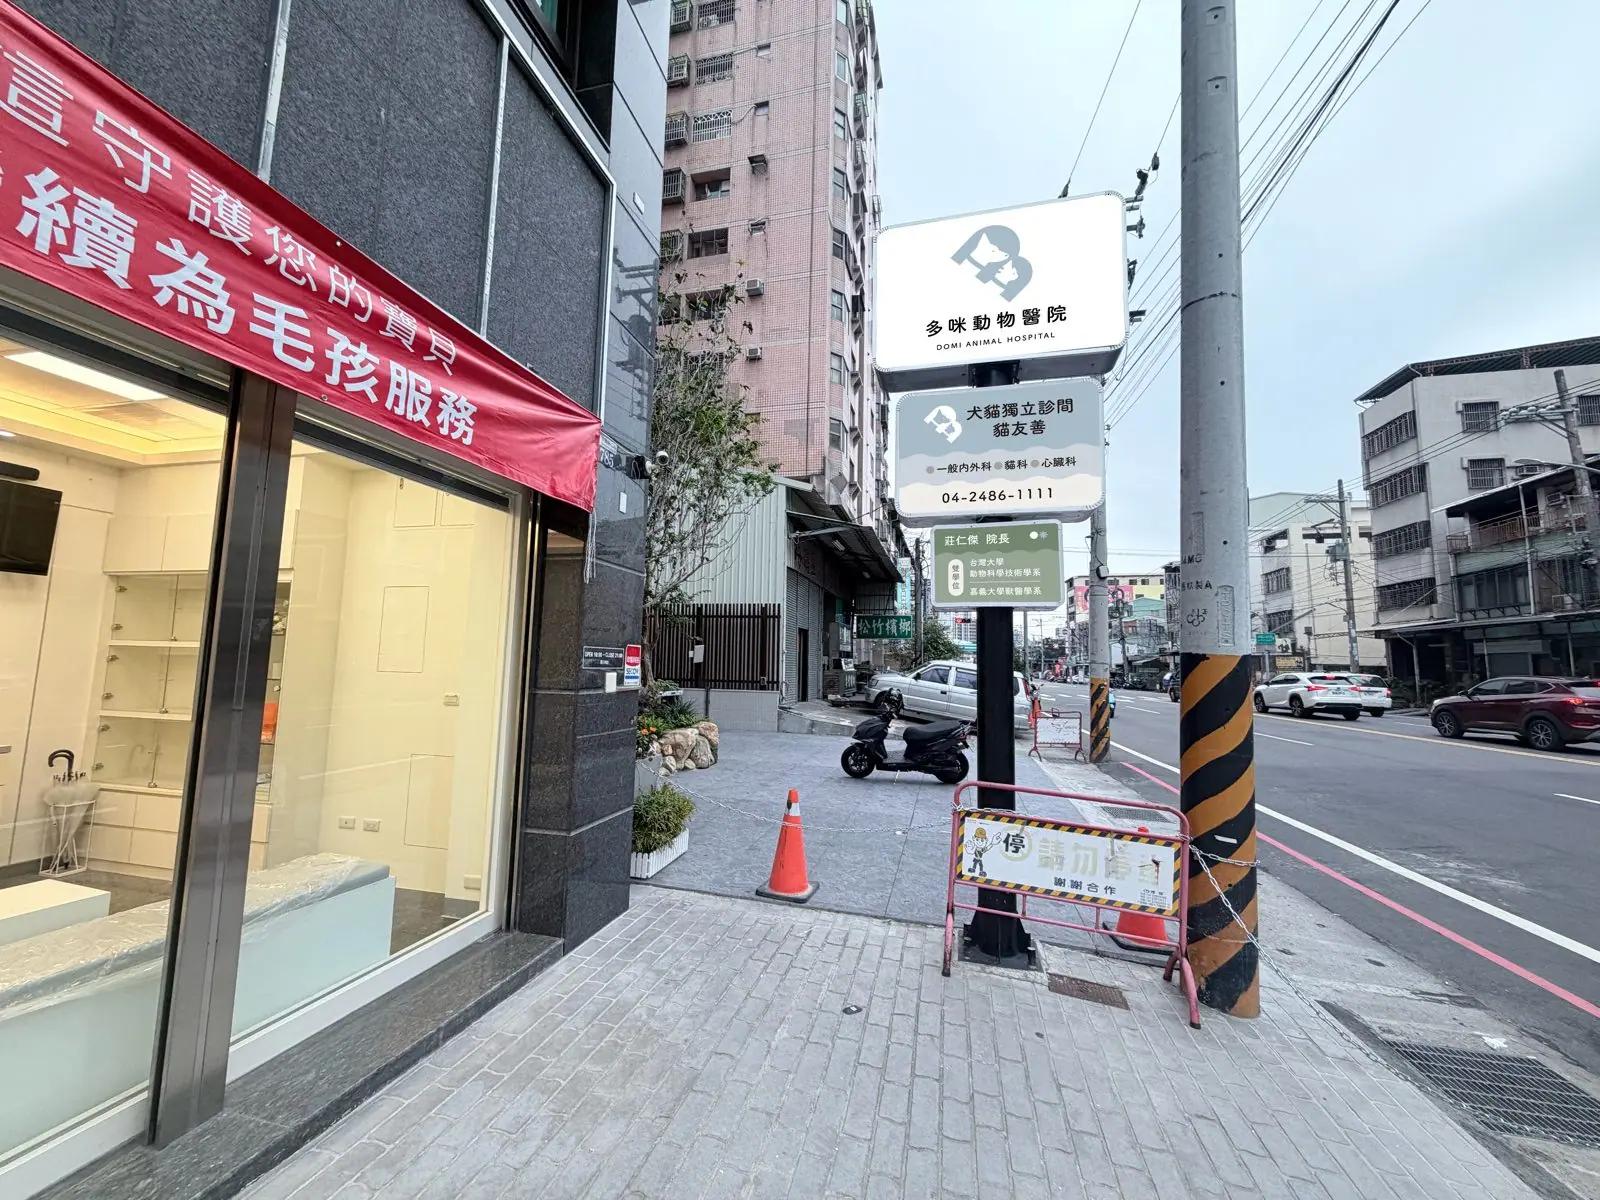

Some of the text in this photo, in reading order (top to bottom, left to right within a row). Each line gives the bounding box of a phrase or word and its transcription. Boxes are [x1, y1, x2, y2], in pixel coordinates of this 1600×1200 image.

[0, 150, 478, 446] 續為毛孩服務
[926, 304, 1067, 338] 多咪動物醫院
[936, 332, 1055, 351] DOMI ANIMAL HOSPITAL
[966, 398, 1073, 421] 犬貓獨立診間
[992, 419, 1046, 438] 貓友善
[1004, 459, 1028, 471] 貓科
[942, 487, 1053, 504] 04-2486-1111
[986, 533, 1010, 545] 院長
[1053, 876, 1117, 895] 謝謝合作
